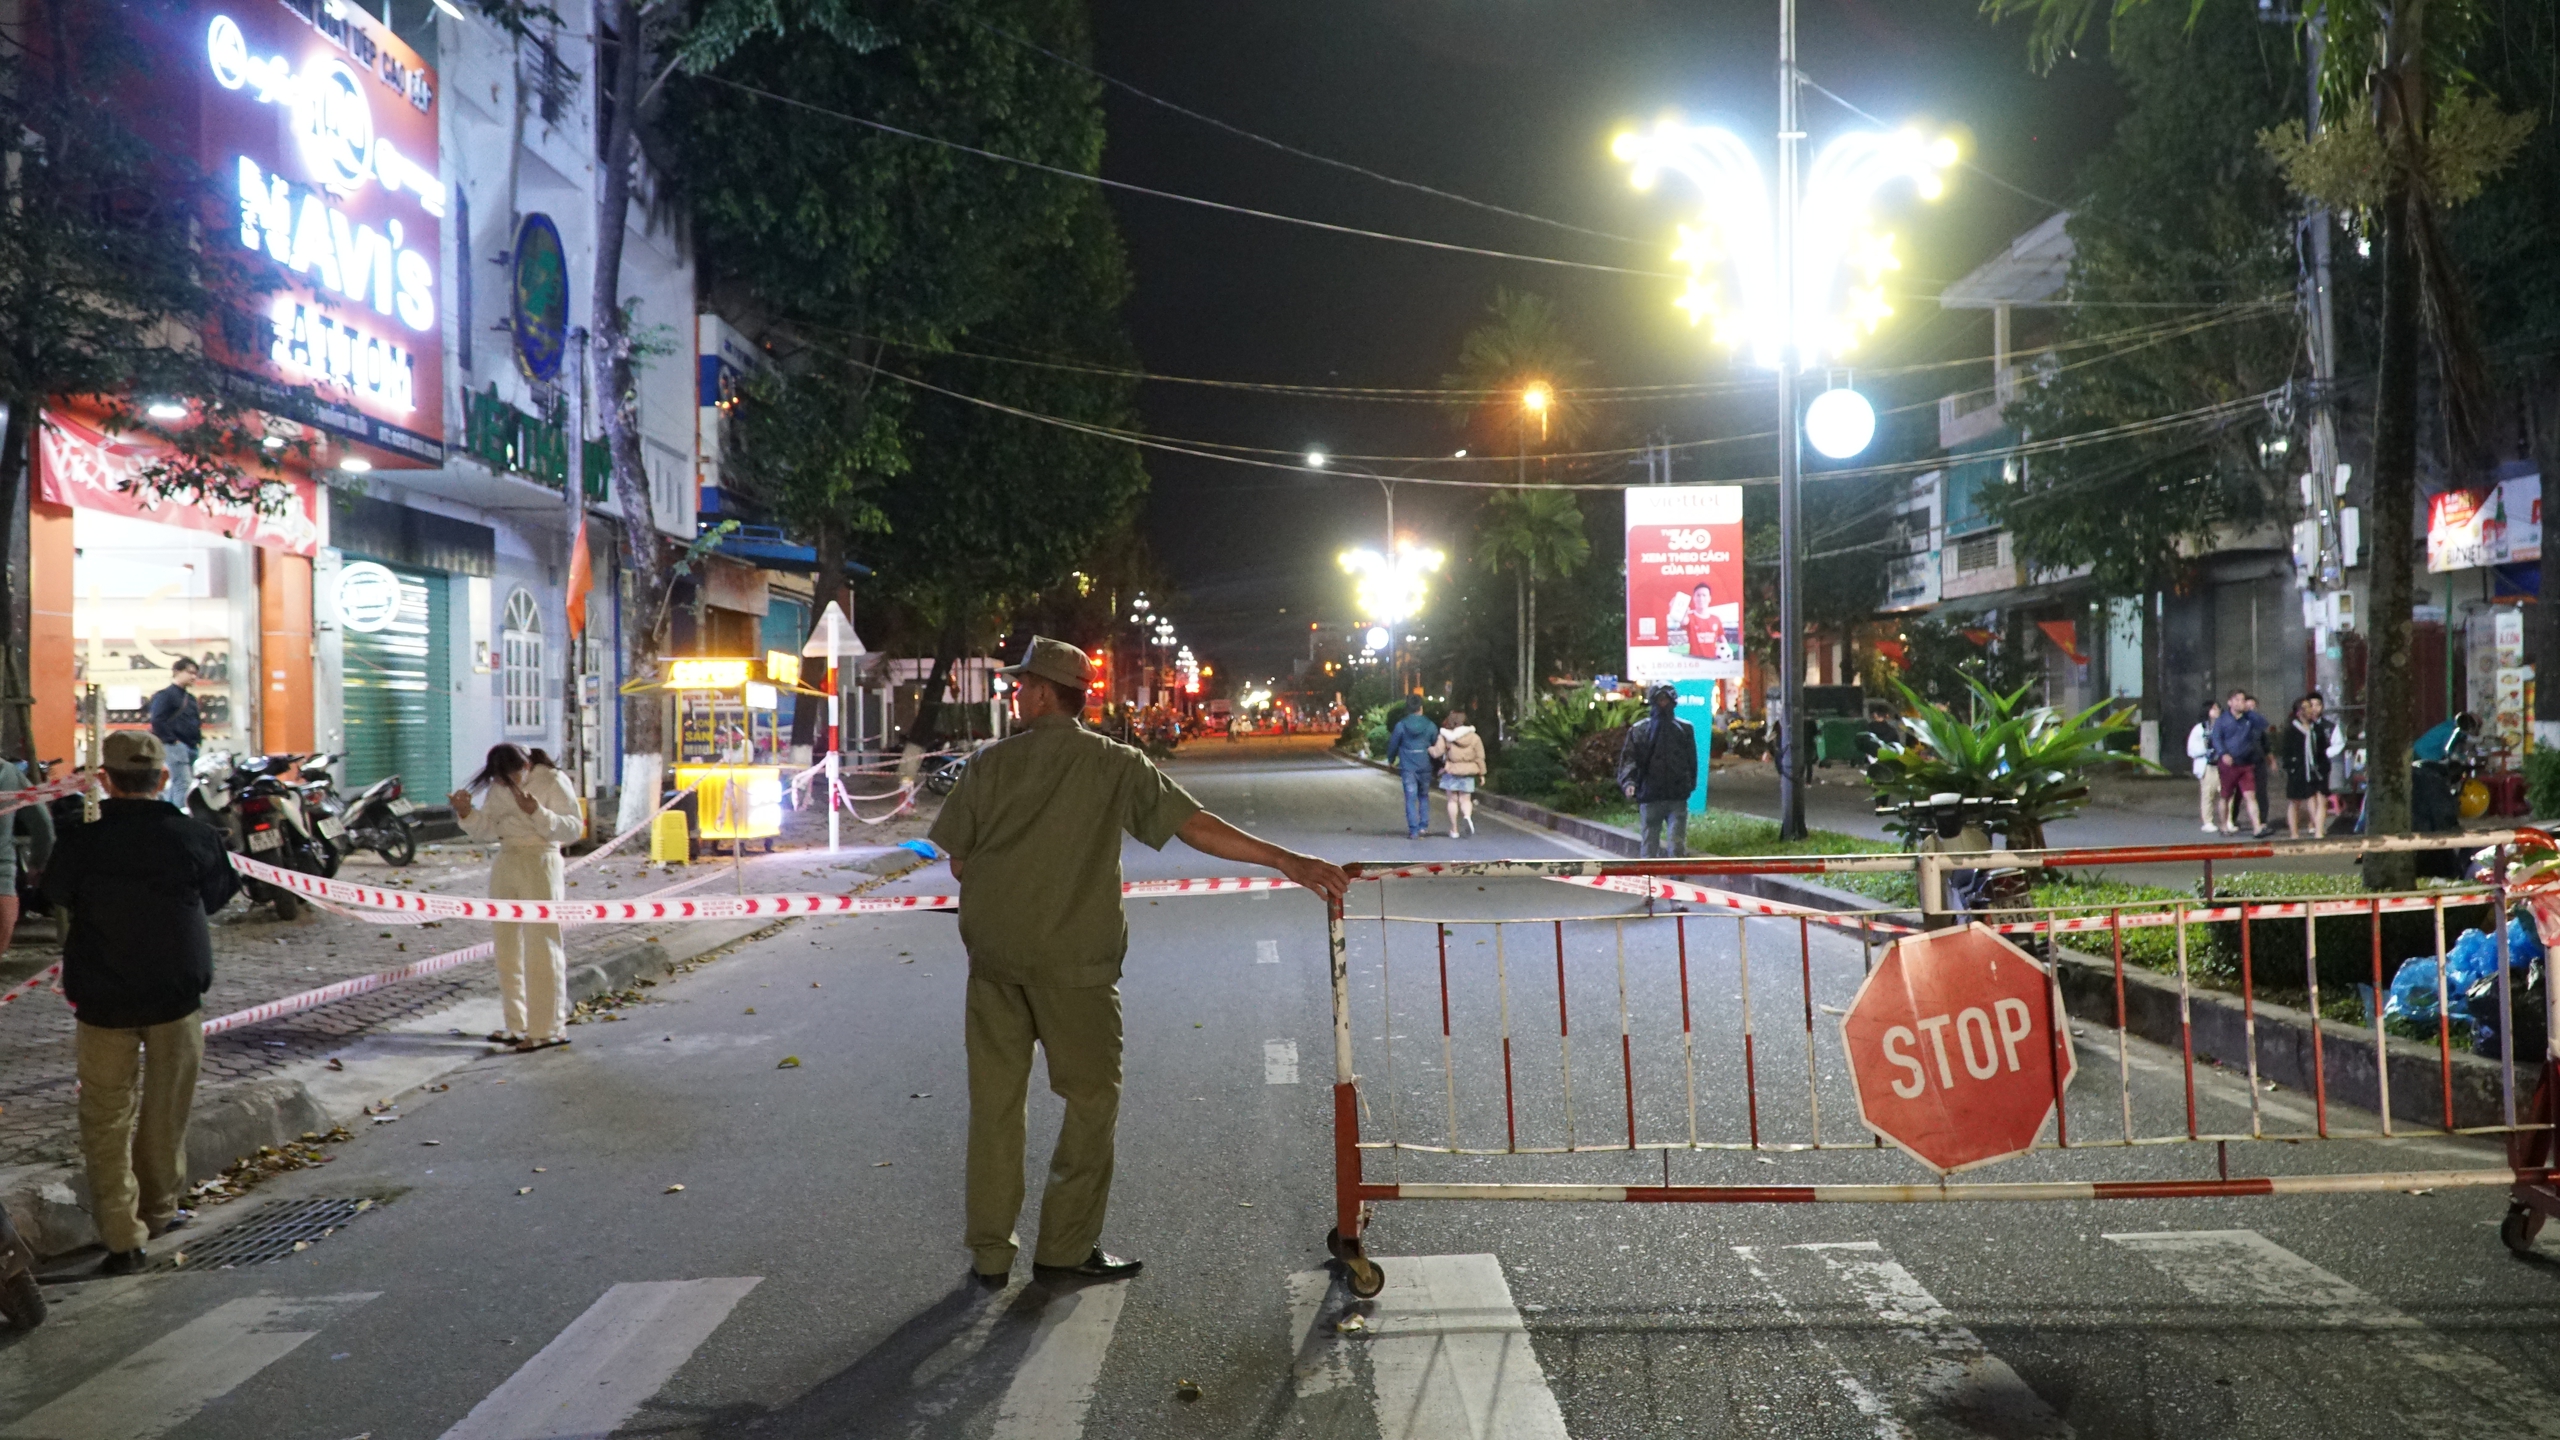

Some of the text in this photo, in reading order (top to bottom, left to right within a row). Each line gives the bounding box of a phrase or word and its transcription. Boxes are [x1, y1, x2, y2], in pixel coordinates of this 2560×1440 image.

[238, 154, 436, 332] NAVI'S
[1649, 493, 1721, 508] viettel
[1641, 549, 1730, 564] XEM THEO CÁCH
[1660, 562, 1710, 576] CỦA BẠN
[1882, 997, 2032, 1099] STOP
